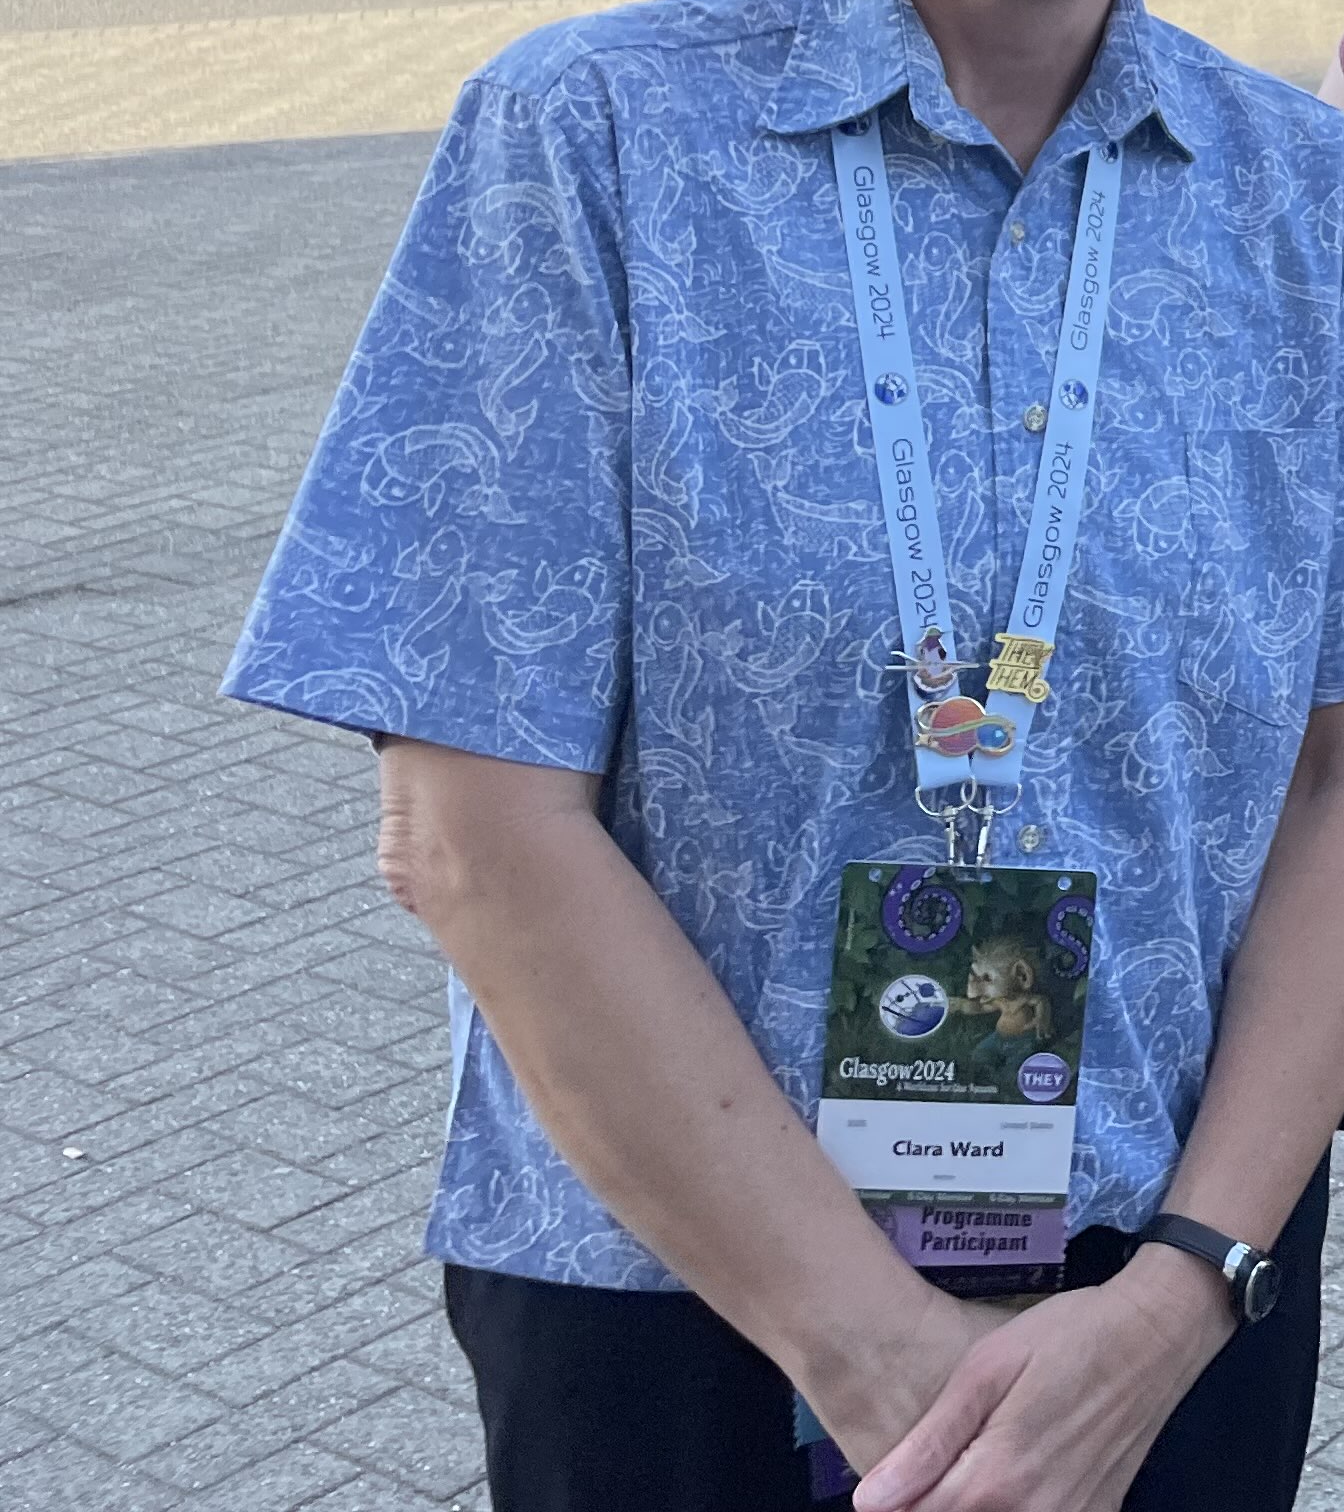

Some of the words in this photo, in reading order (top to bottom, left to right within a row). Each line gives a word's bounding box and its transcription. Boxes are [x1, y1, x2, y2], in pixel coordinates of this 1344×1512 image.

[854, 166, 881, 277] Glasgow
[869, 284, 896, 340] 2024
[1070, 249, 1100, 351] Glasgow
[1085, 190, 1106, 244] 2024
[892, 438, 923, 561] Glasgow
[911, 569, 938, 630] 2024
[1023, 506, 1062, 628] Glasgow
[1049, 441, 1075, 500] 2024
[989, 663, 1040, 690] THEM
[840, 1057, 955, 1085] Glasgow2024
[1023, 1072, 1063, 1087] THEY
[893, 1140, 943, 1157] Clara
[950, 1141, 1005, 1158] Ward
[921, 1206, 1033, 1229] Programme
[920, 1231, 1028, 1256] Participant
